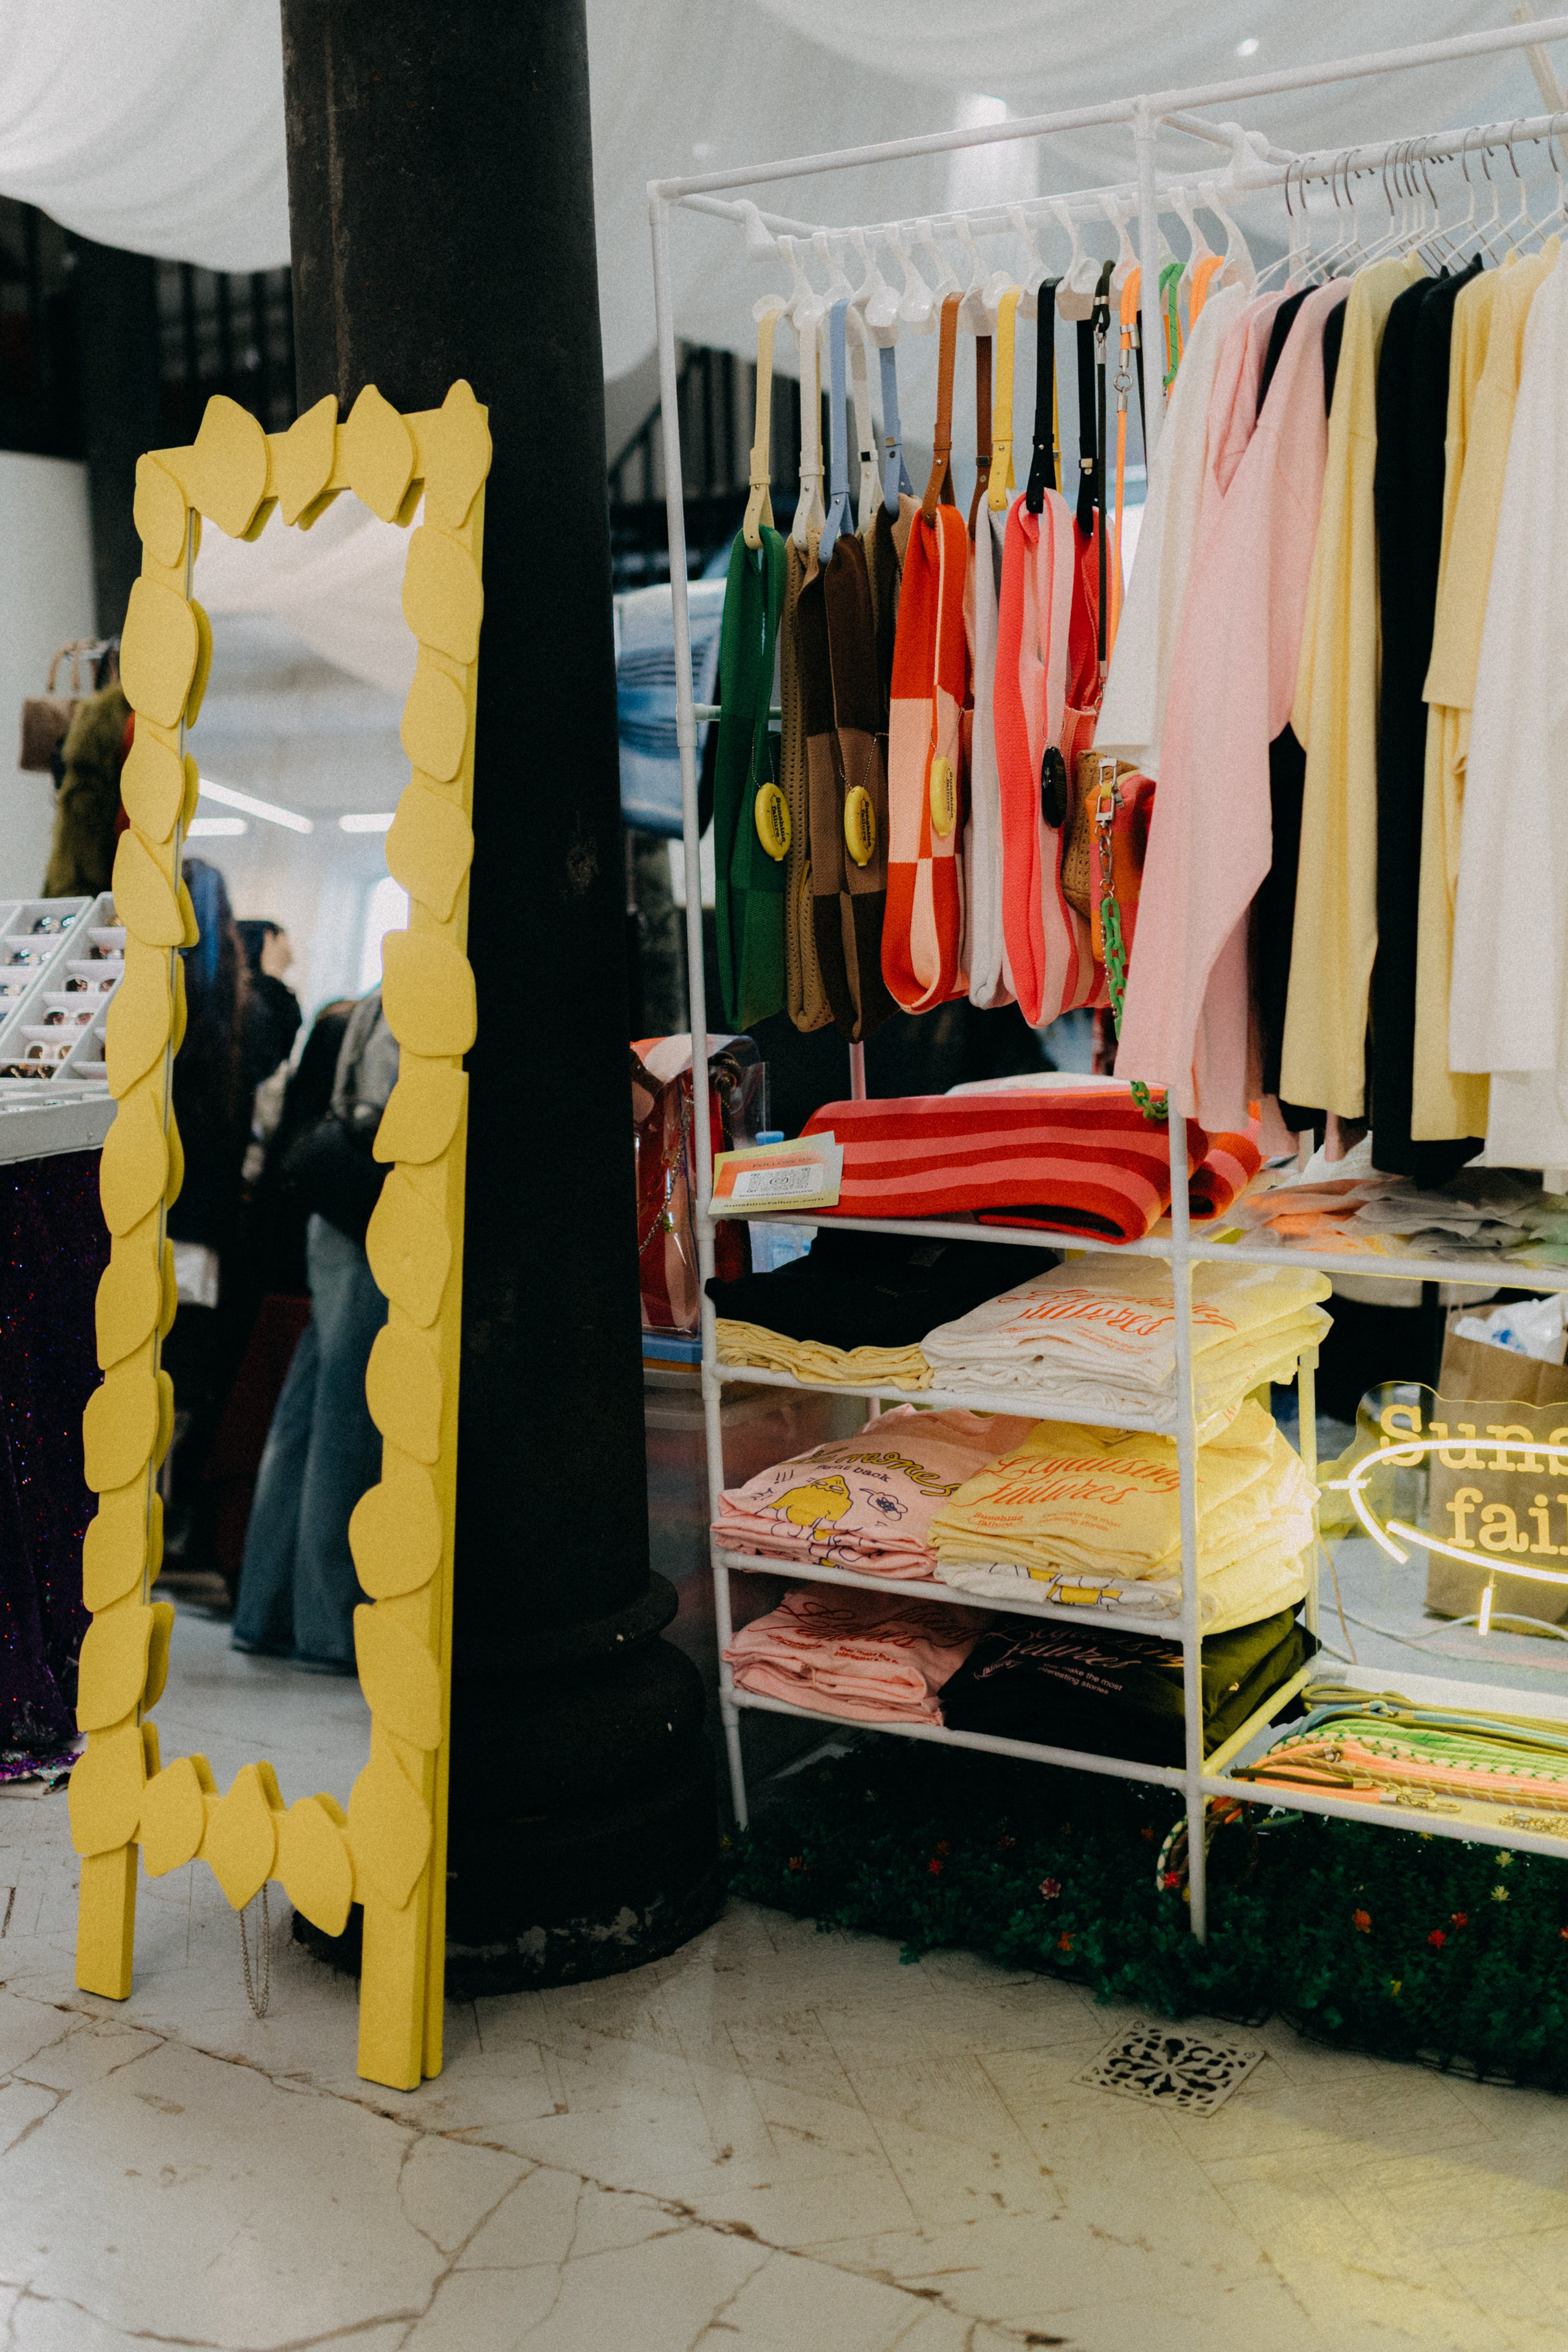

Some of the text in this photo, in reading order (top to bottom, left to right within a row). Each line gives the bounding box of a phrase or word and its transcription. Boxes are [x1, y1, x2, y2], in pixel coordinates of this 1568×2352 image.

[776, 797, 786, 842] Sunshine
[752, 1159, 796, 1168] FOLLOW
[723, 1197, 824, 1208] sunshinefailure.com
[853, 1466, 893, 1483] back
[973, 1512, 1024, 1521] Sunshine
[1037, 1666, 1110, 1696] interesting stories
[1061, 1666, 1085, 1677] make
[1085, 1672, 1100, 1684] the
[1101, 1678, 1124, 1692] most
